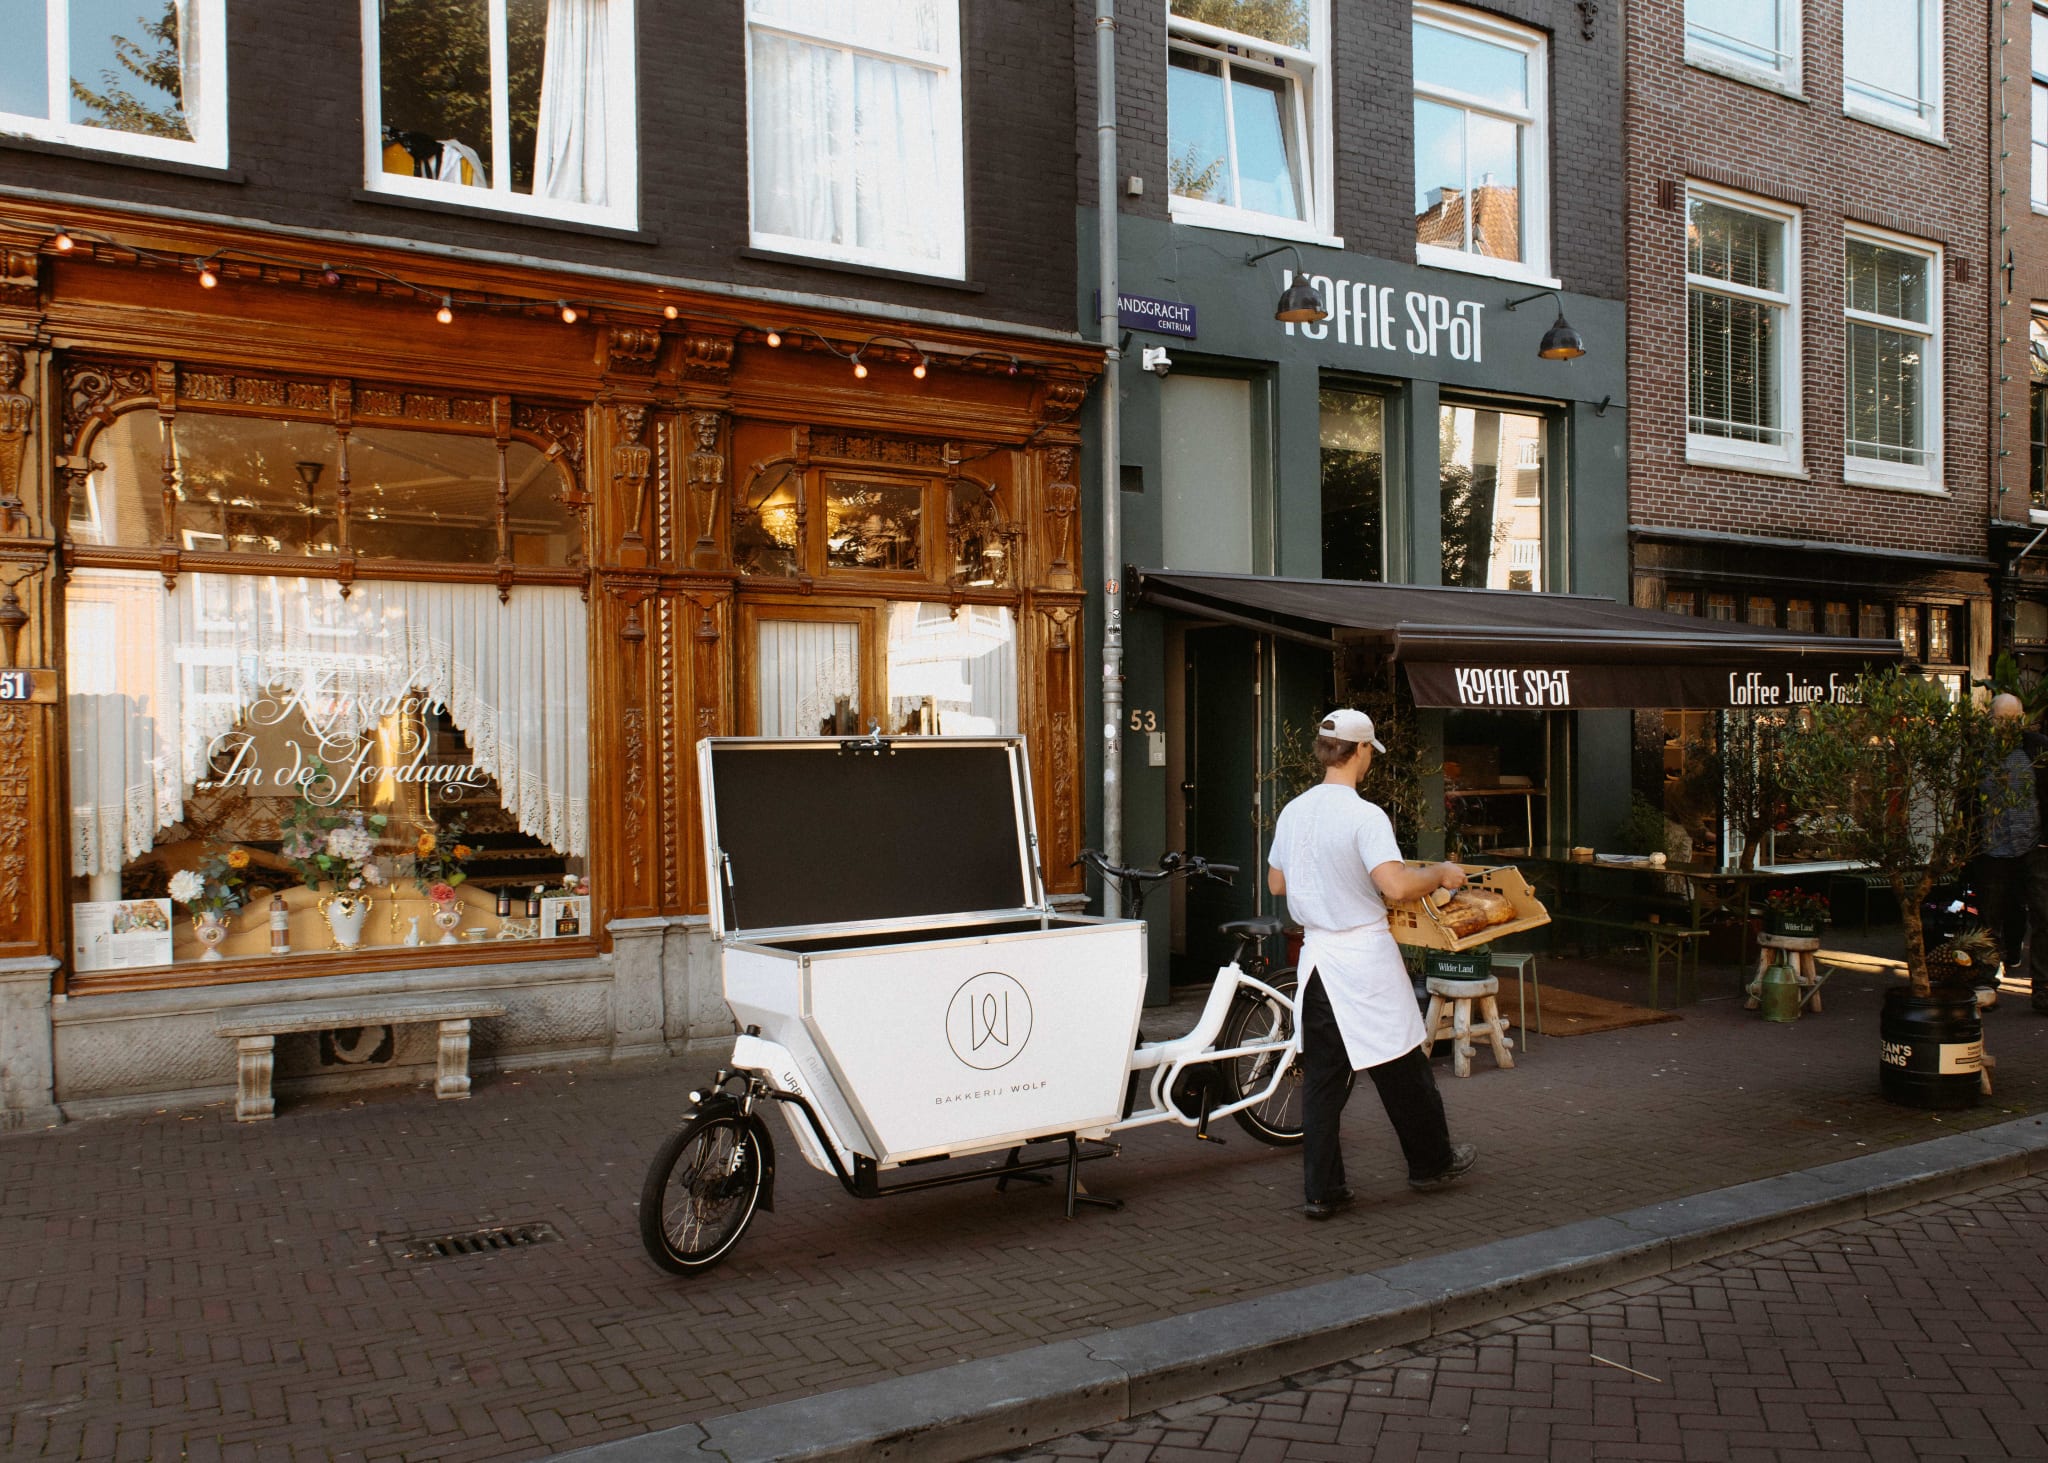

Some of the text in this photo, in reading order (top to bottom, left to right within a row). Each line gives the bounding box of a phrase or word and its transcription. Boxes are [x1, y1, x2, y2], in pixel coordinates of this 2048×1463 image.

[1117, 297, 1190, 321] ANDSGRACHT
[1158, 320, 1191, 333] CENTRUM
[1405, 291, 1485, 362] SPOT
[0, 672, 26, 699] 51
[1455, 668, 1570, 705] KOFFIE SPOT
[1729, 672, 1780, 704] Coffee
[1785, 672, 1824, 704] Juice
[249, 663, 446, 747] Kapsalon
[1130, 709, 1157, 731] 53
[274, 740, 315, 786] de
[304, 719, 490, 806] Jordaan
[1439, 962, 1474, 973] Wilder Land
[1881, 1040, 1912, 1057] EAN'S
[1881, 1051, 1907, 1067] EANS
[935, 1081, 1047, 1105] BAKKERIJ WOLF
